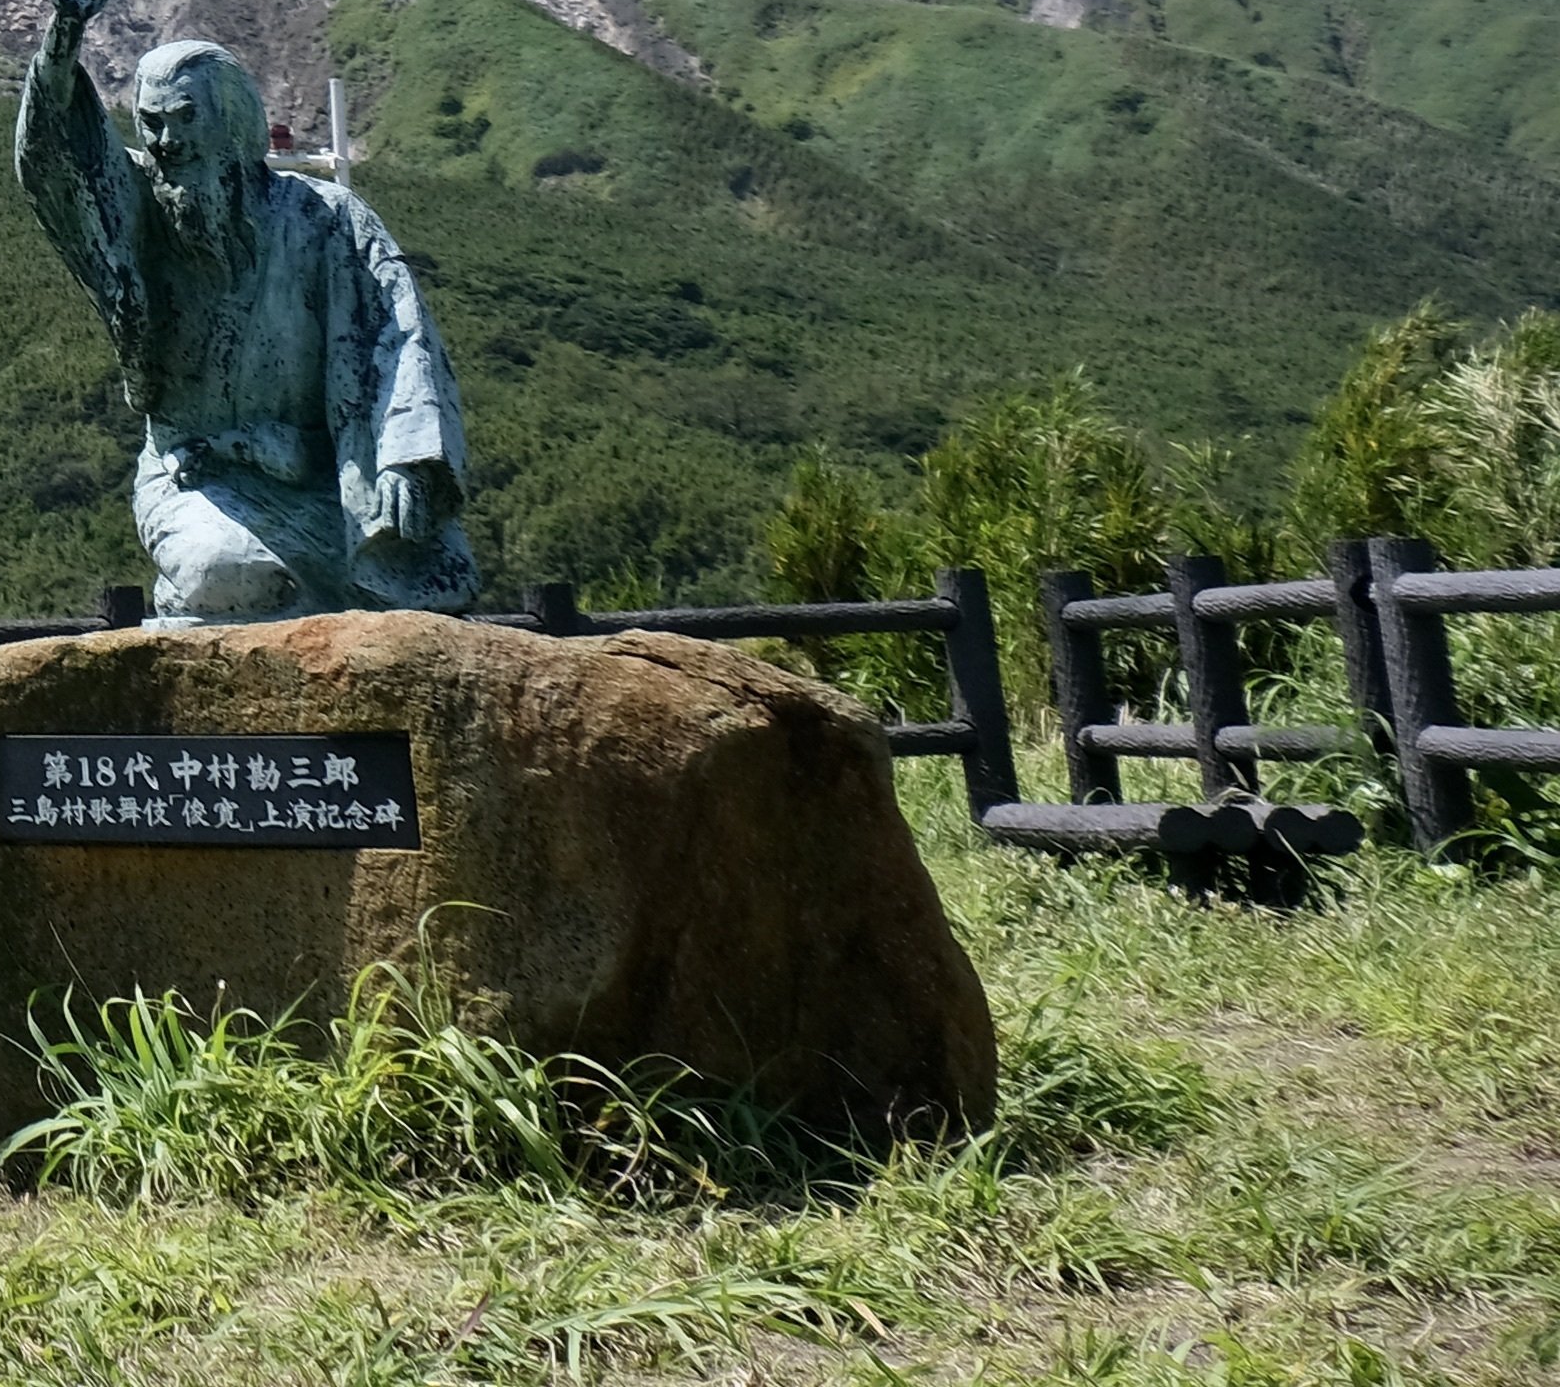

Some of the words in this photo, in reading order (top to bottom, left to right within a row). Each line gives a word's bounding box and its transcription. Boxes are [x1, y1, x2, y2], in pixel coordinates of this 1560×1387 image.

[42, 750, 159, 791] 第18代
[168, 750, 360, 792] 中村勘三郎
